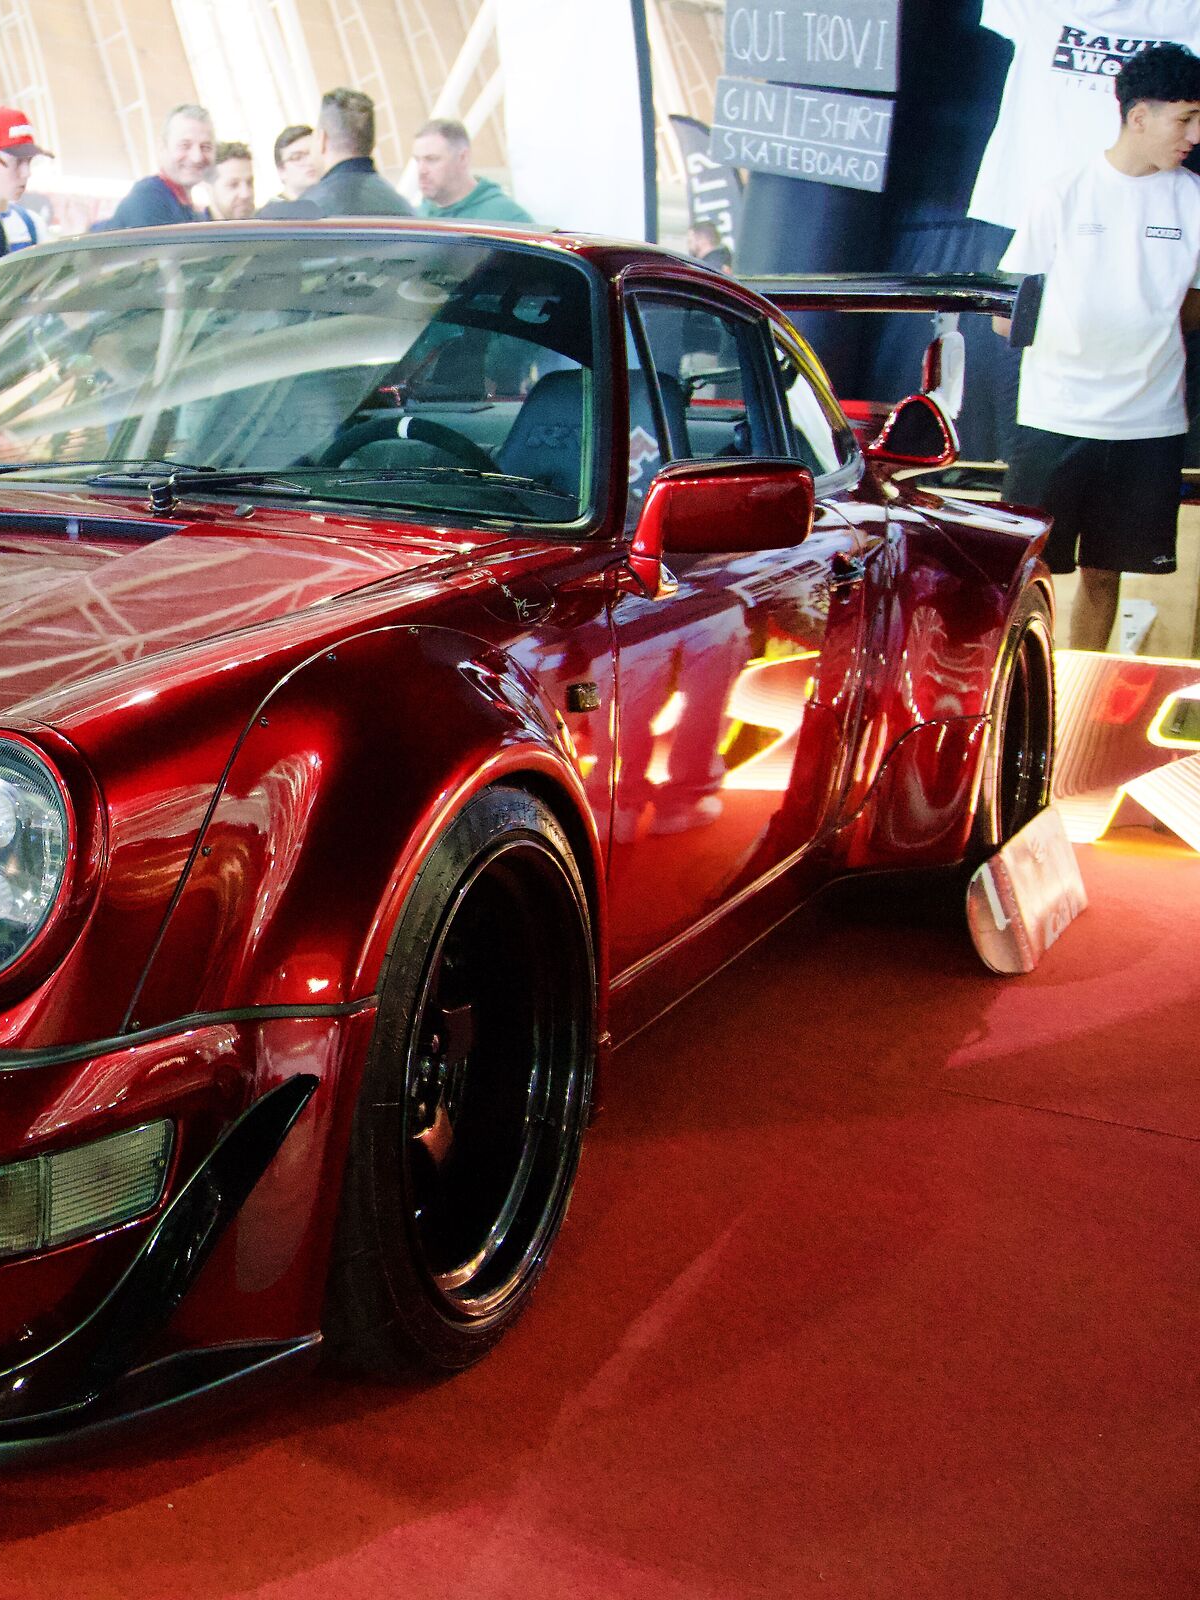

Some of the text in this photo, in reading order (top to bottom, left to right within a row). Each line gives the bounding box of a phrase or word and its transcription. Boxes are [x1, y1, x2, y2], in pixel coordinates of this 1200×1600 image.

[730, 8, 889, 71] QUI TROVI
[1057, 49, 1122, 75] -We
[1065, 78, 1111, 94] ITAL
[722, 87, 891, 144] GIN T-SHIRT
[723, 129, 879, 183] SKATEBOARD
